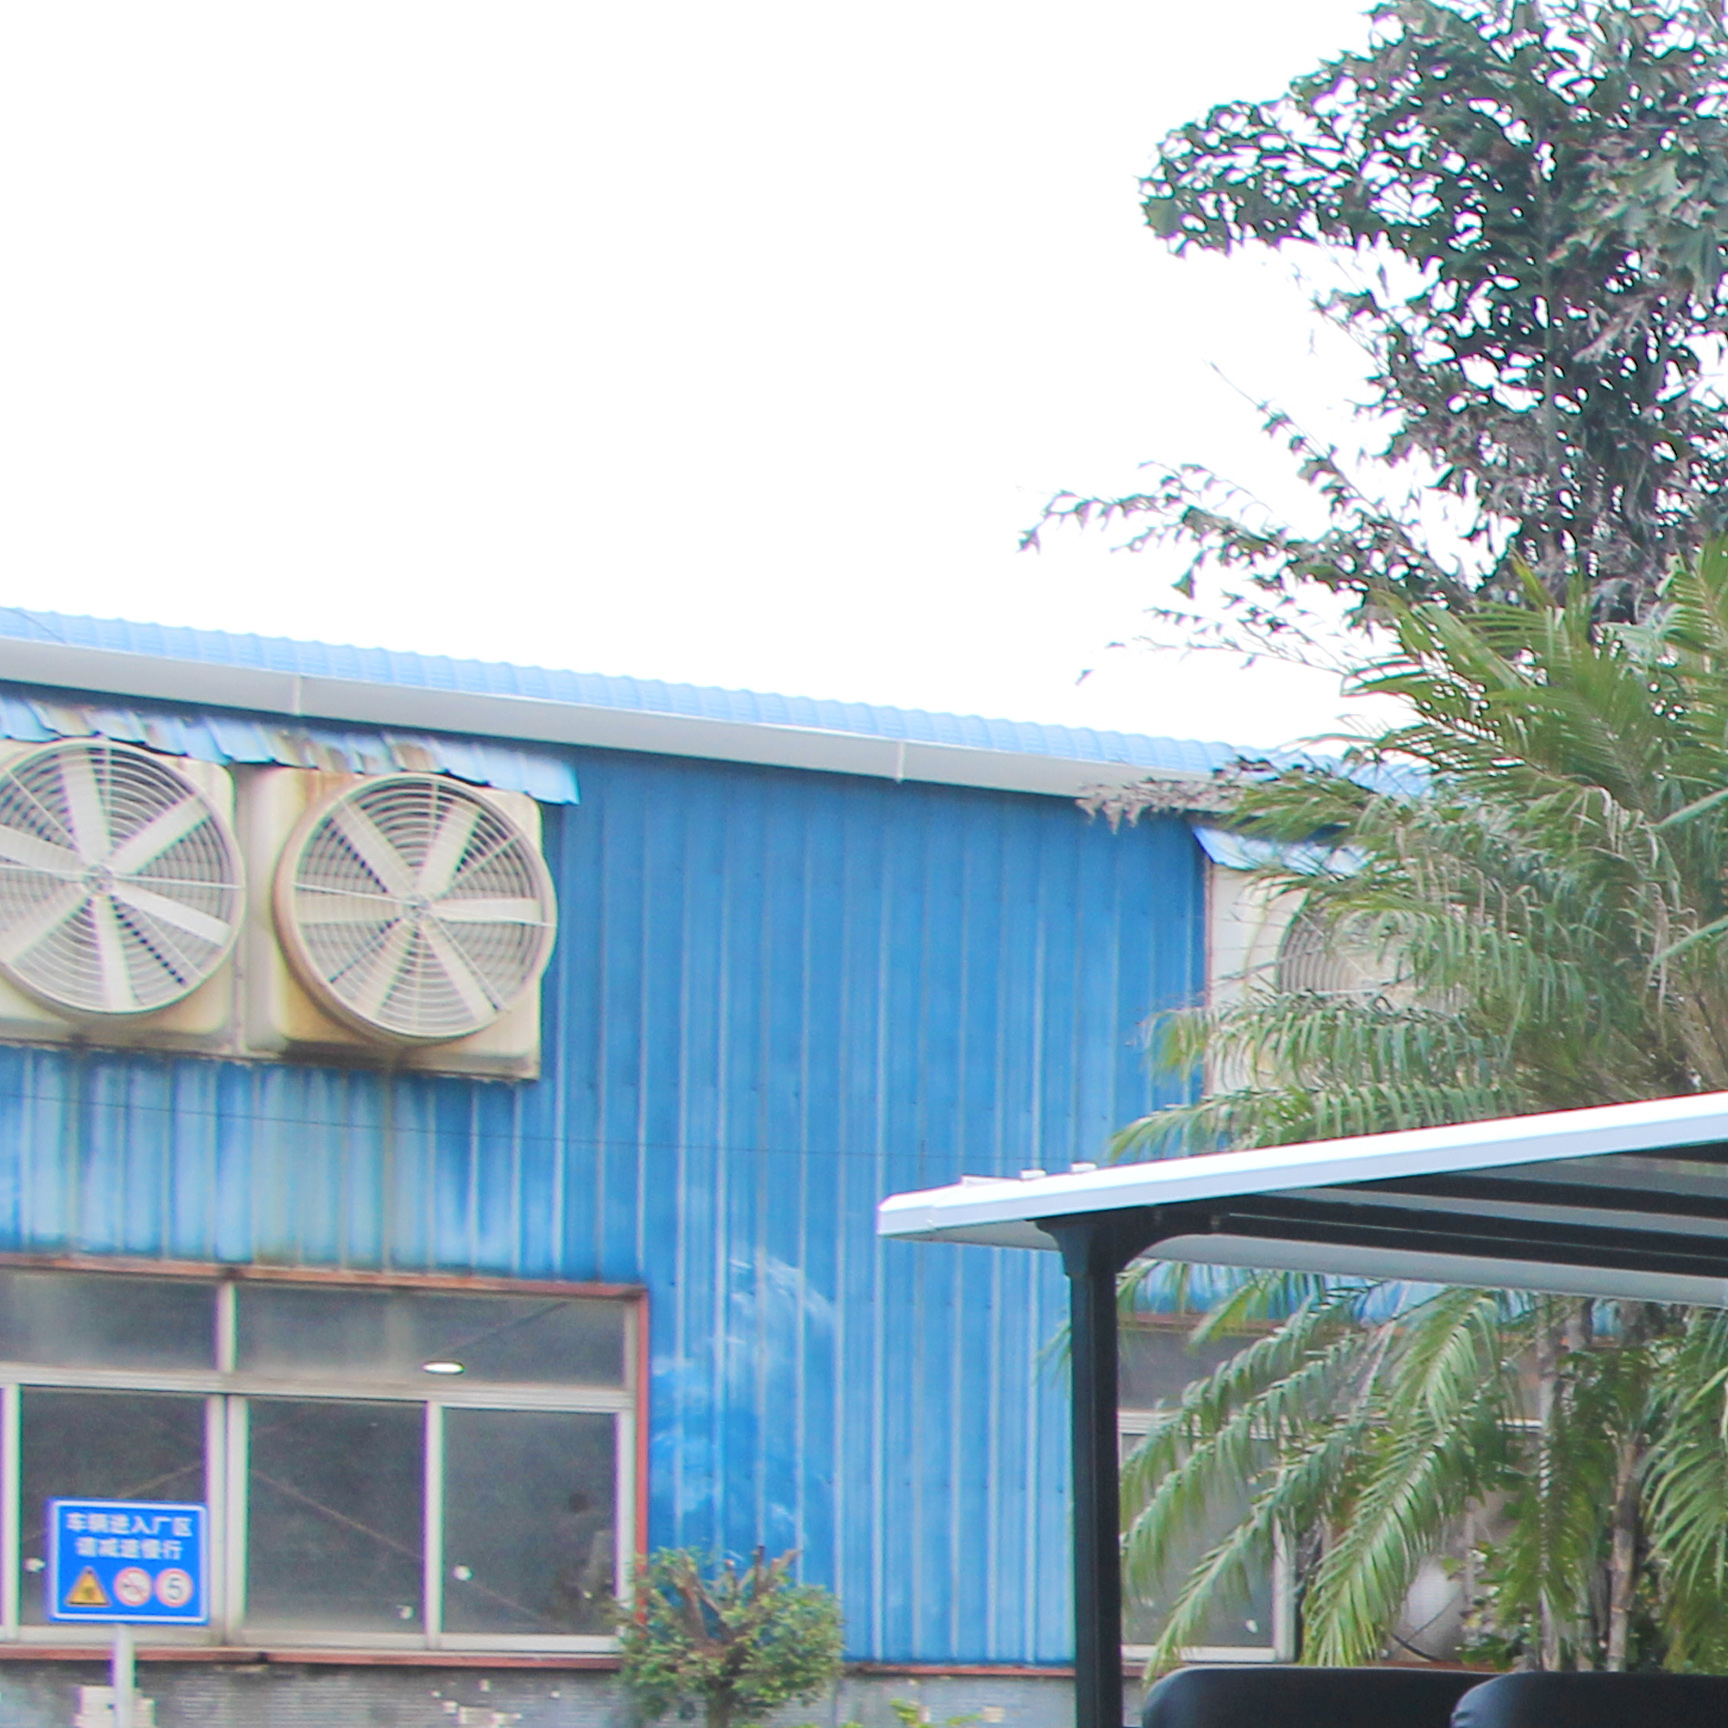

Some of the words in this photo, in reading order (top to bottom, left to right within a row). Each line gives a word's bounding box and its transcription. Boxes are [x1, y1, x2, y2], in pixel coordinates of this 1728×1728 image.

[66, 1512, 192, 1537] 车辆进入厂区
[76, 1536, 182, 1560] 请减速慢行
[167, 1576, 183, 1600] 5
